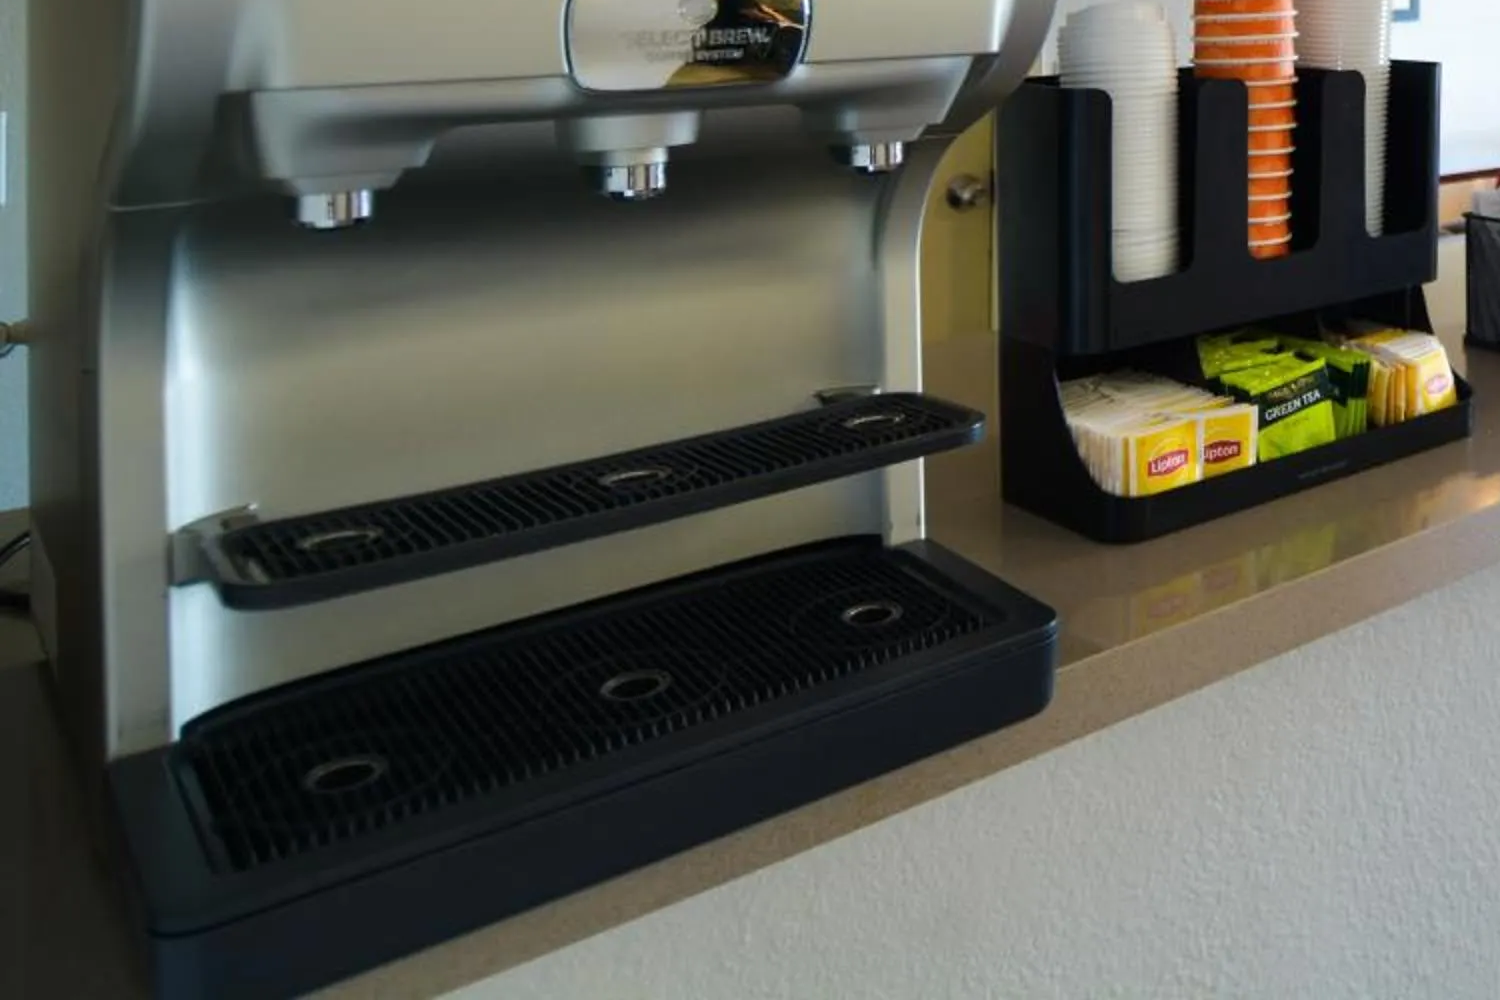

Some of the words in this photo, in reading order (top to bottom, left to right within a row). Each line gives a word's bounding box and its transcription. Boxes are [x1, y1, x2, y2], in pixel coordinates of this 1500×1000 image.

[1265, 398, 1302, 421] GREEN
[1302, 388, 1321, 405] TEA
[1151, 452, 1187, 474] Lipton
